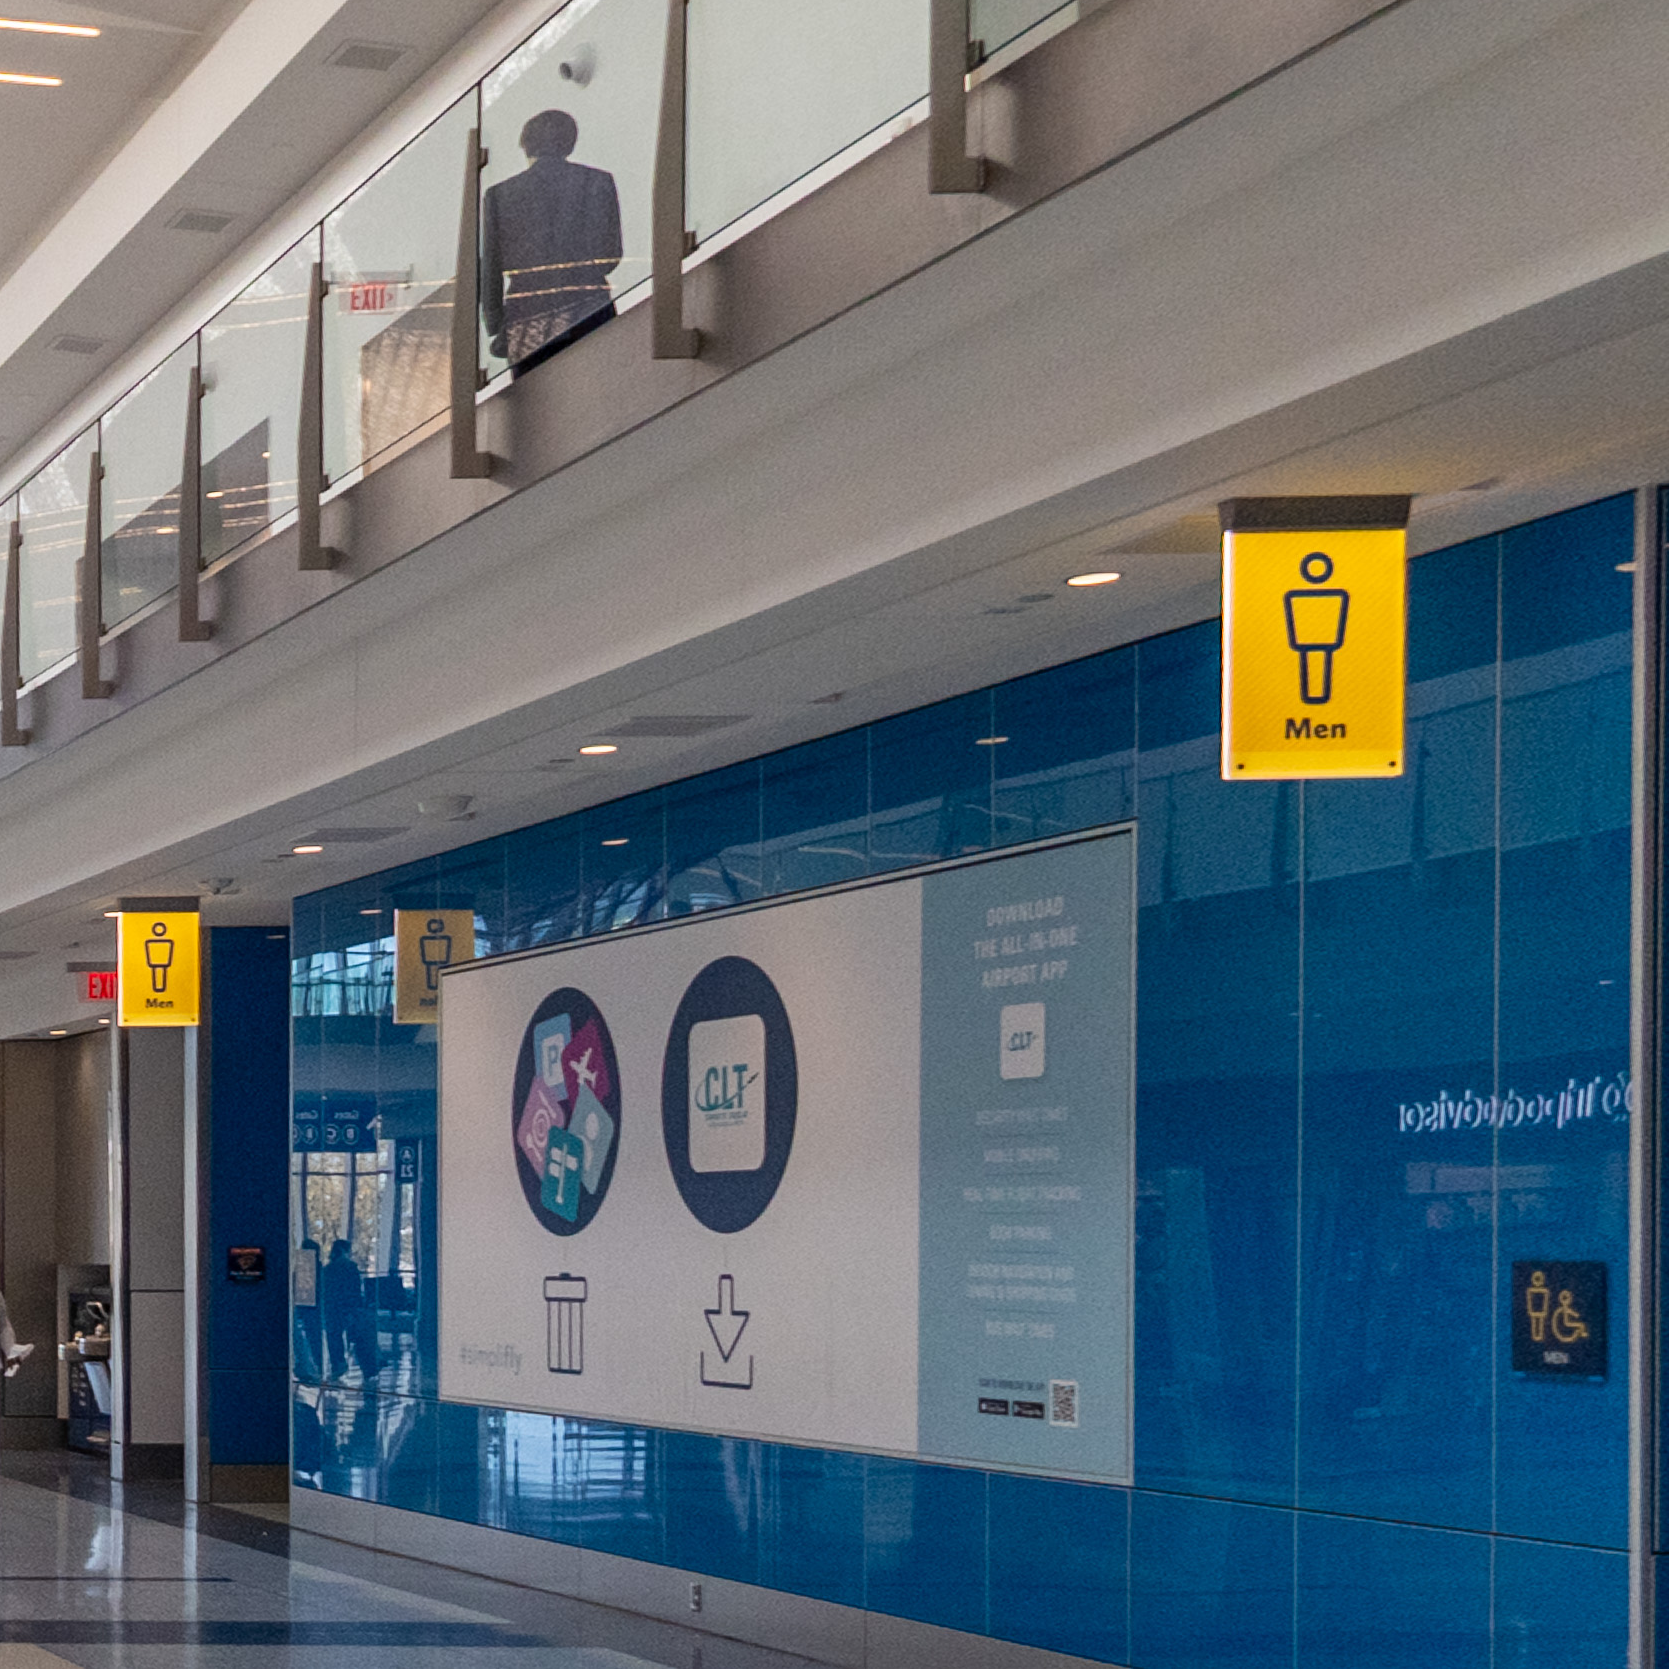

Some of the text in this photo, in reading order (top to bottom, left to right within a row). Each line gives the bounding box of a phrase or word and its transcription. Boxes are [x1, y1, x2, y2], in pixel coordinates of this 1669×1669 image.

[351, 282, 386, 311] EXIT
[1285, 717, 1346, 739] Men
[987, 895, 1064, 927] DOWNLOAD
[974, 925, 1078, 959] THE ALL-IN-ONE
[89, 972, 118, 999] EXI
[982, 960, 1068, 988] AIRPORT APP
[146, 998, 174, 1008] Men
[1009, 1032, 1033, 1052] CLT
[705, 1063, 748, 1110] CLT
[1543, 1351, 1569, 1364] MEN
